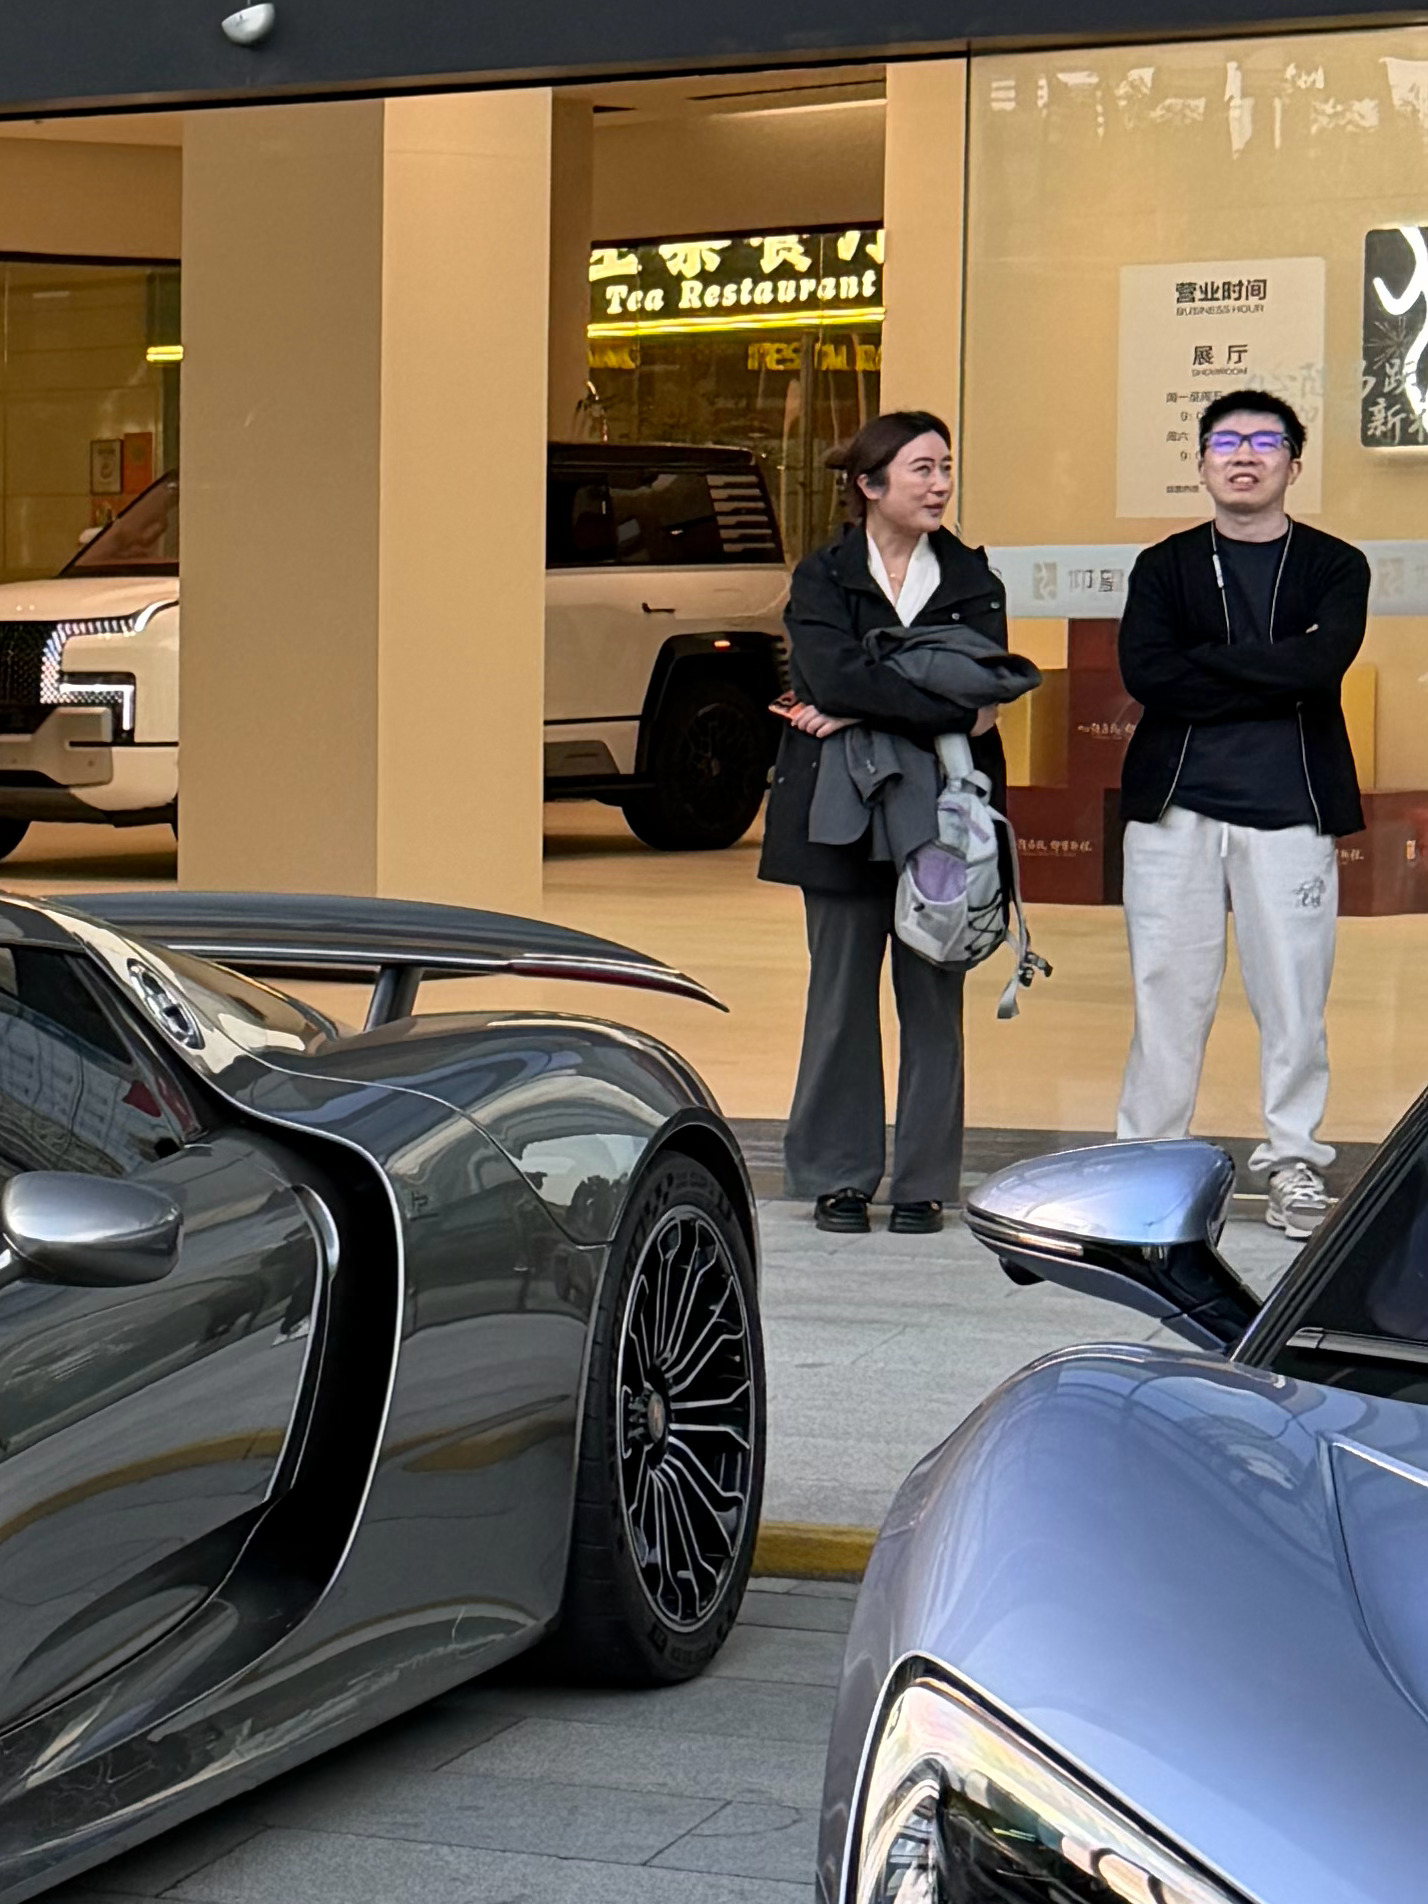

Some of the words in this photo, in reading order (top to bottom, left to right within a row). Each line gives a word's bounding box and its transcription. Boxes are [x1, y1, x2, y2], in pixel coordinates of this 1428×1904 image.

[606, 284, 664, 315] Tea
[678, 269, 877, 309] Restaurant
[1175, 279, 1268, 304] 营业时间
